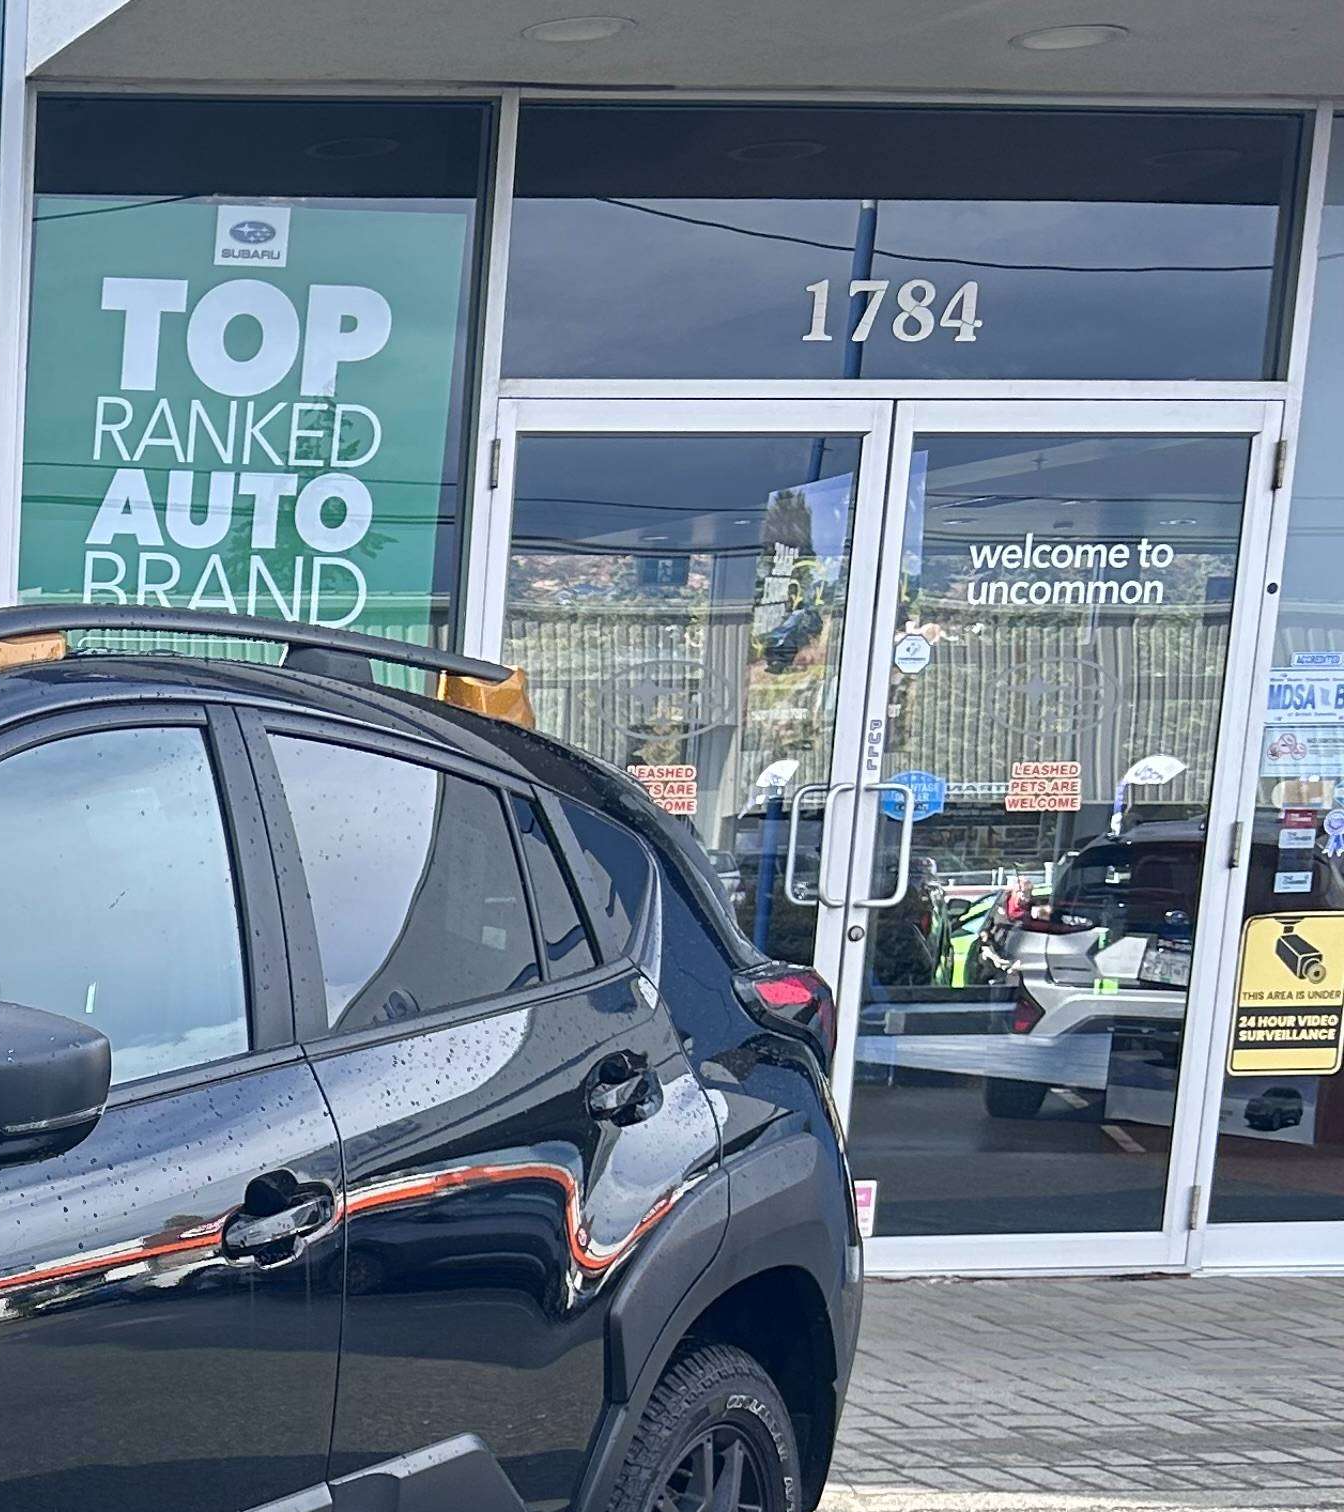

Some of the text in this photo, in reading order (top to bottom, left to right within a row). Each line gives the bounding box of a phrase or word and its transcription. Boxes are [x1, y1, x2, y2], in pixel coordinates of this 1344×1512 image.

[221, 248, 281, 260] SUBARU
[801, 278, 983, 343] 1784
[100, 276, 393, 397] TOP
[92, 396, 382, 468] RANKED
[84, 468, 374, 553] AUTO
[969, 532, 1175, 569] welcome to
[81, 550, 368, 629] BRAND
[966, 580, 1164, 606] uncommon
[866, 719, 883, 771] PULL
[1013, 764, 1079, 776] LEASHED
[666, 784, 695, 796] ARE
[1011, 781, 1047, 792] PETS
[1050, 781, 1079, 792] ARE
[1007, 797, 1079, 809] WELCOME
[1242, 990, 1342, 1001] THIS AREA IS UNDER
[1238, 1014, 1339, 1028] 24 HOUR VIDEO
[1238, 1028, 1337, 1042] SURVEILLANCE
